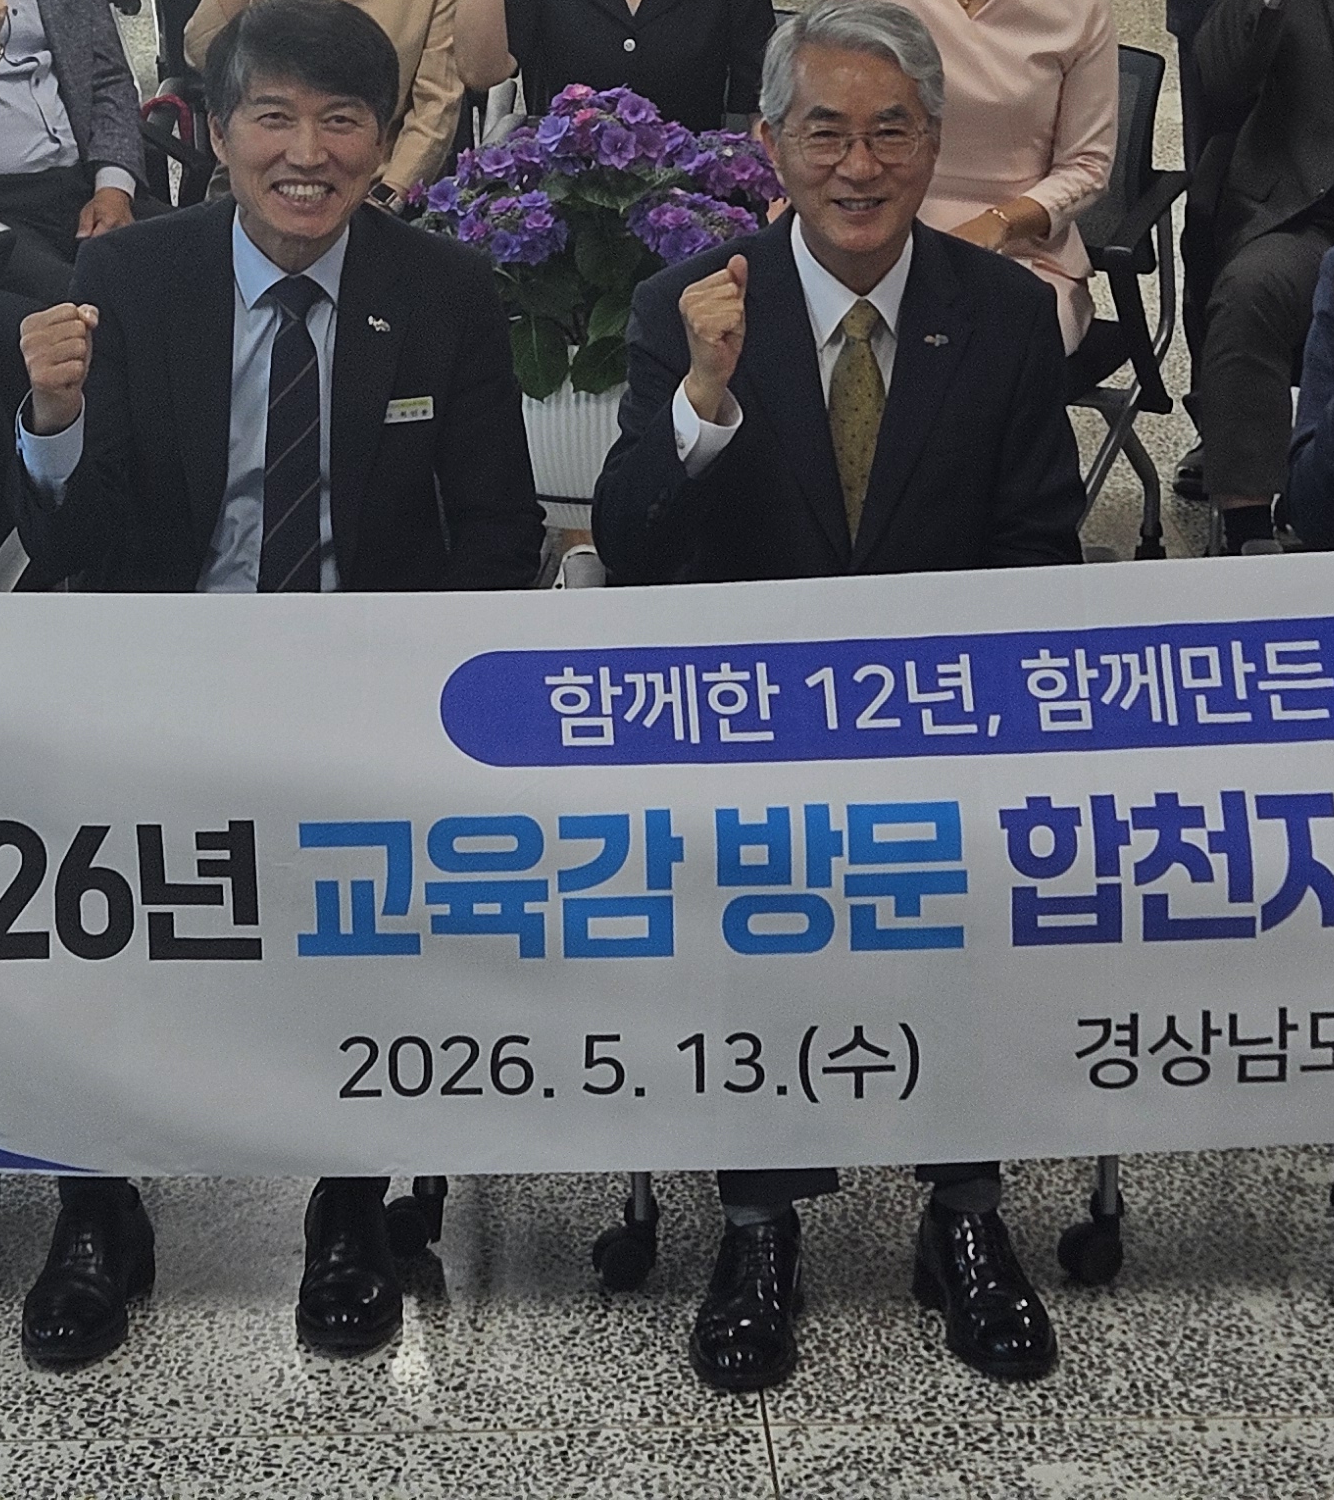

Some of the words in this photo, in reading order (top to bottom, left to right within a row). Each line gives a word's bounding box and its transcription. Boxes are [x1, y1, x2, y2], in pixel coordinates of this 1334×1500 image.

[544, 661, 781, 747] 함께한
[805, 650, 1004, 740] 12년,
[297, 808, 684, 960] 교육감
[715, 799, 969, 956] 방문
[339, 1034, 555, 1099] 2026.
[582, 1033, 646, 1098] 5.
[676, 1022, 920, 1104] 13.(수)
